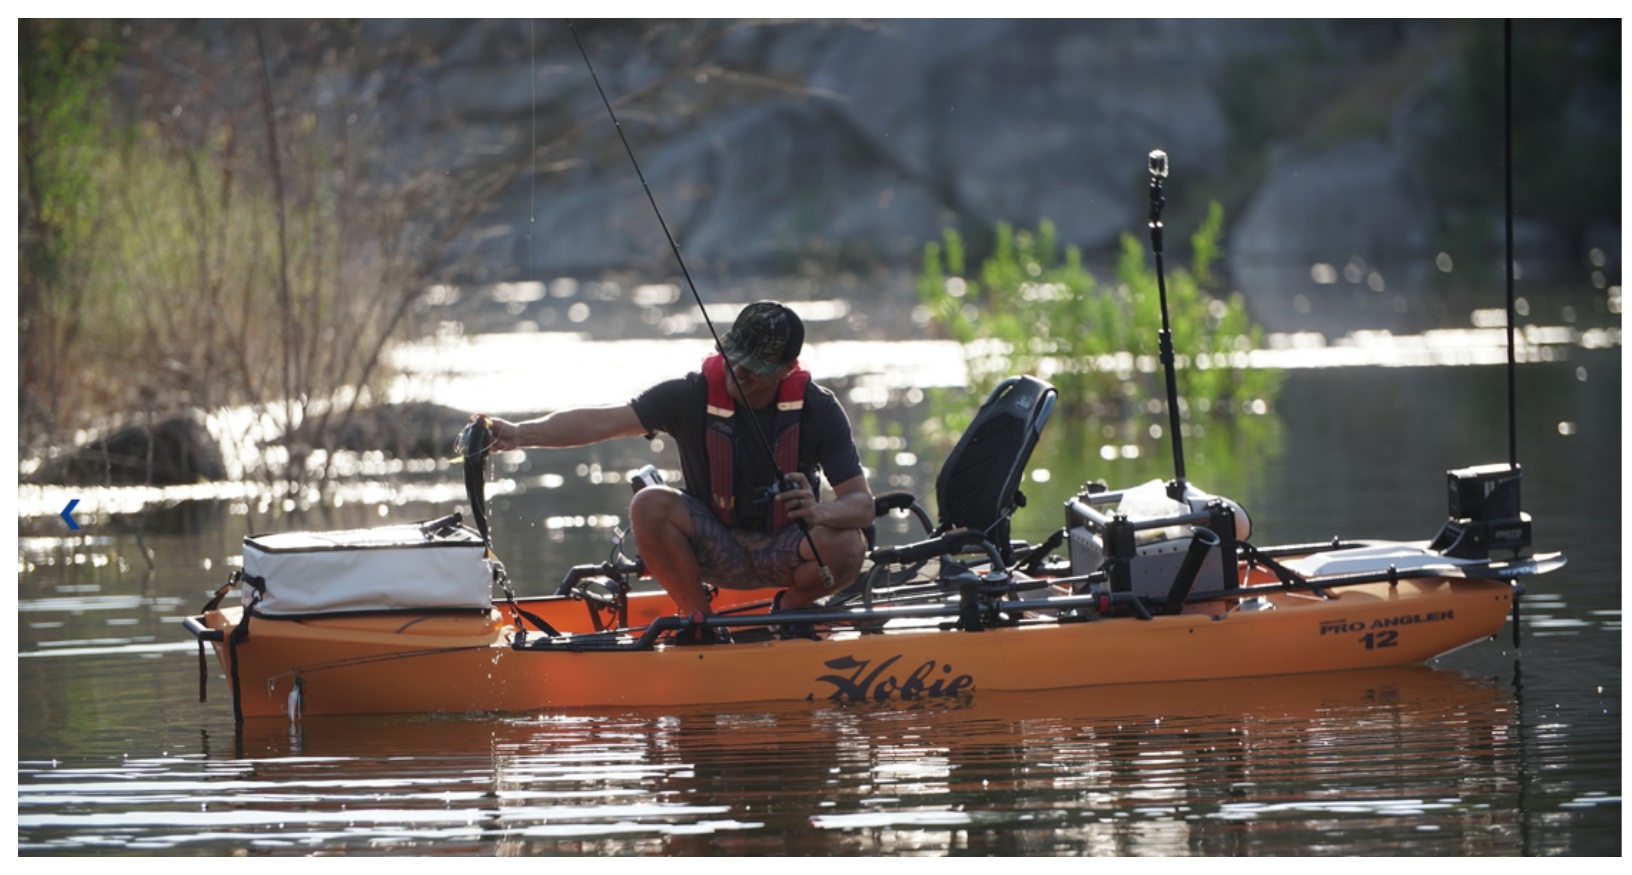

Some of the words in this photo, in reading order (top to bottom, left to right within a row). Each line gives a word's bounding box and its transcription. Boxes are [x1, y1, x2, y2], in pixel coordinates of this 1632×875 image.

[1319, 621, 1366, 636] PRO
[1370, 610, 1454, 630] ANGLER
[1358, 630, 1399, 650] 12
[812, 654, 975, 702] Hobie
